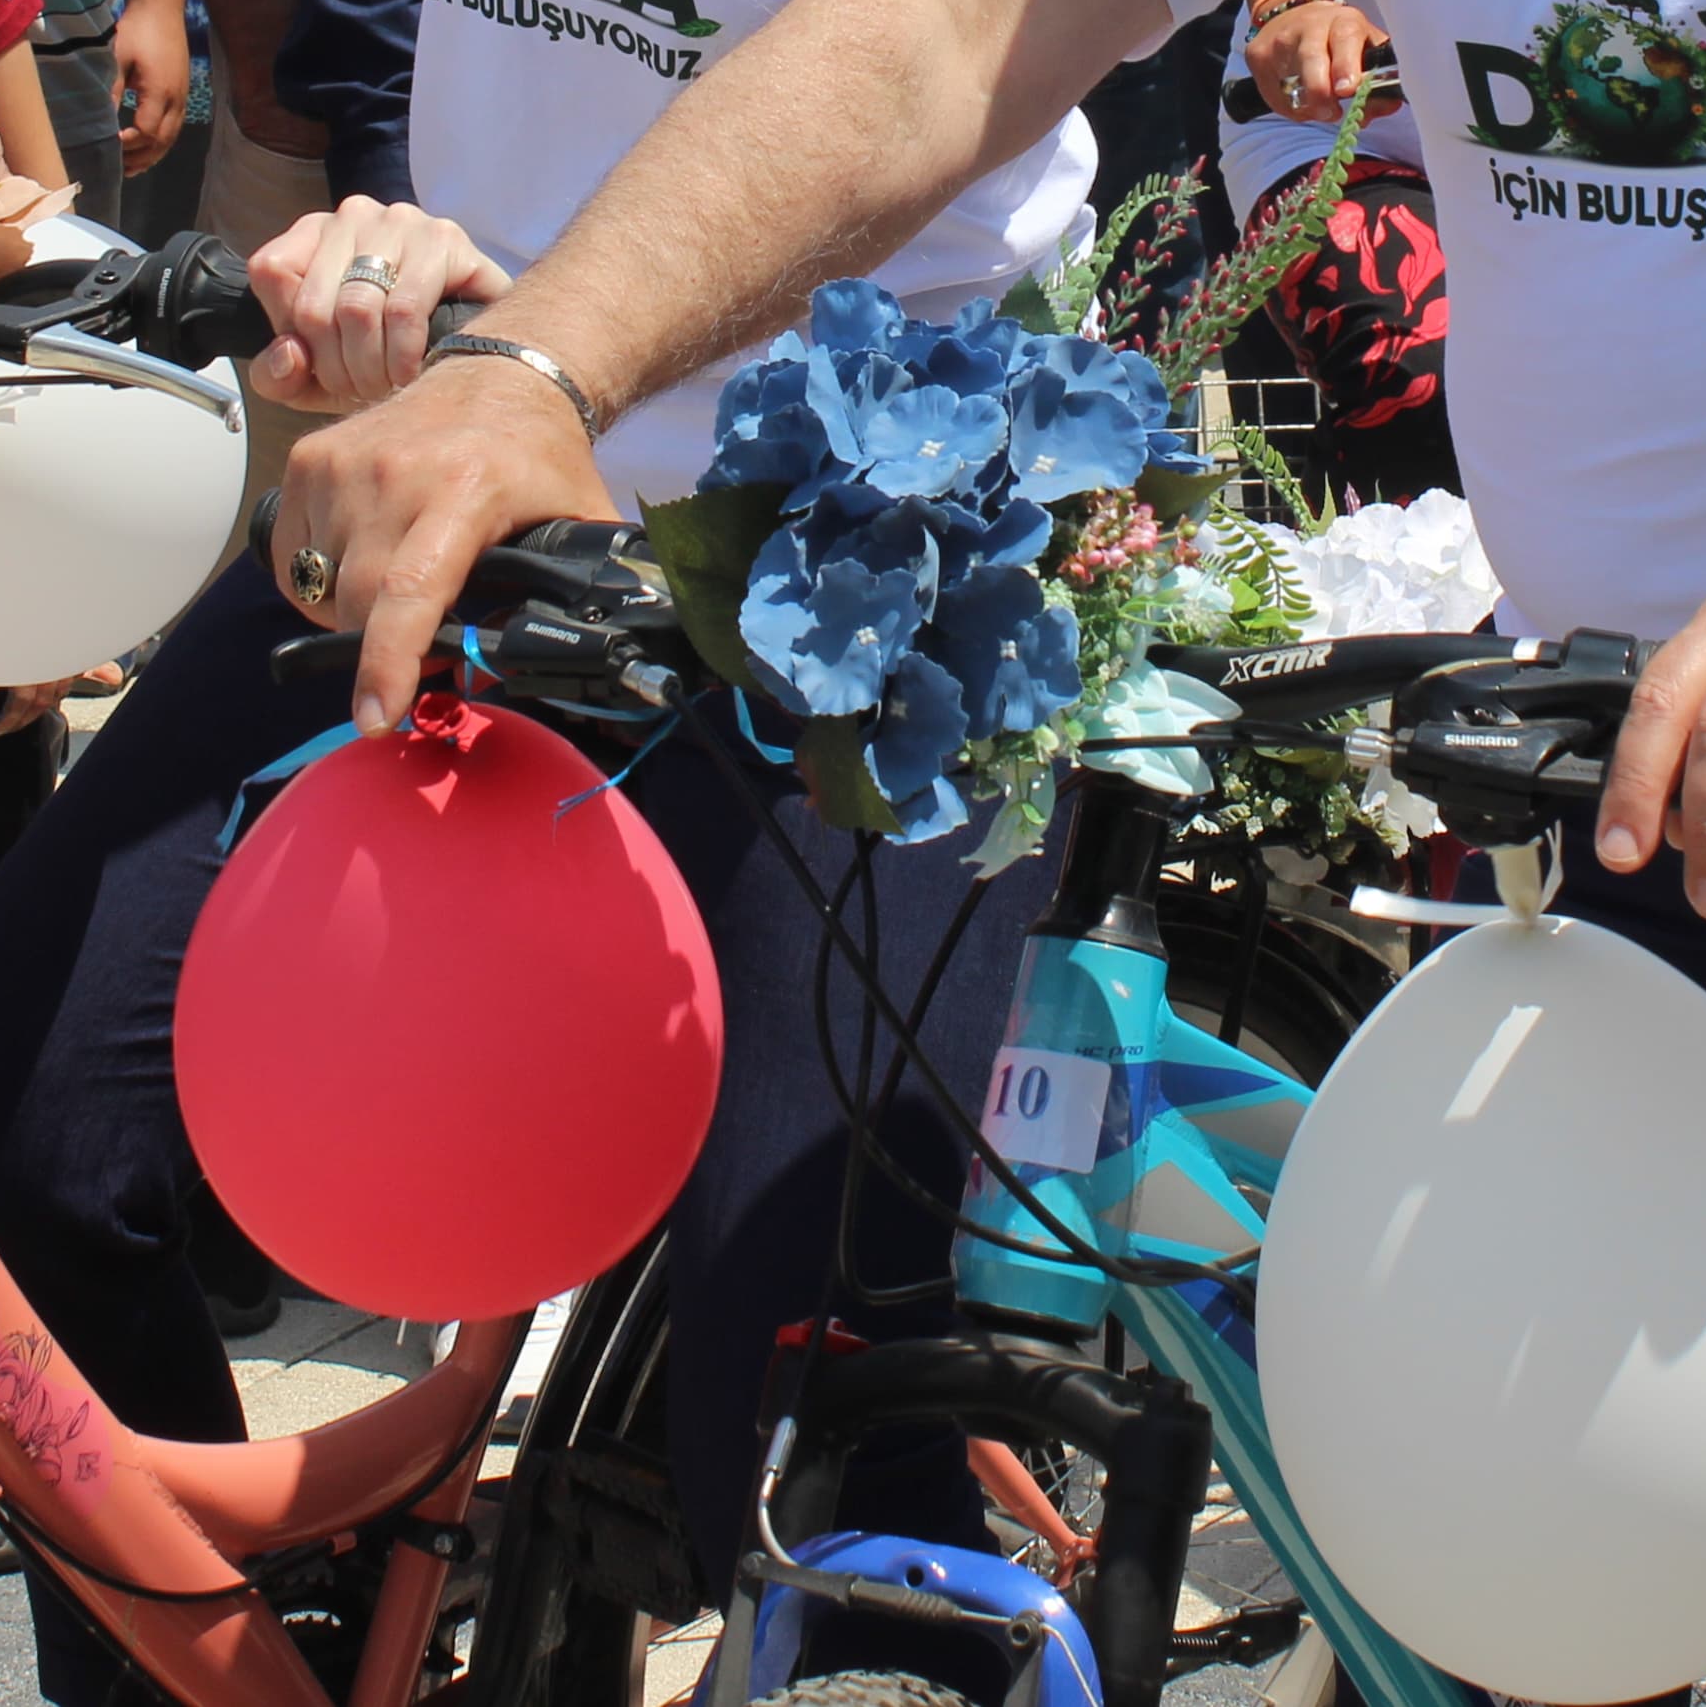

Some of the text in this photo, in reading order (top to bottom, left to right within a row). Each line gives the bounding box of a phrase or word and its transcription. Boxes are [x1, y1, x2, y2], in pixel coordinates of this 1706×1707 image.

[1490, 156, 1567, 221] İÇİN
[524, 621, 581, 644] SHIMANO
[1219, 641, 1333, 687] XCMR
[1444, 734, 1519, 748] SHIMANO
[1108, 1045, 1144, 1059] PRO
[991, 1063, 1051, 1121] 10
